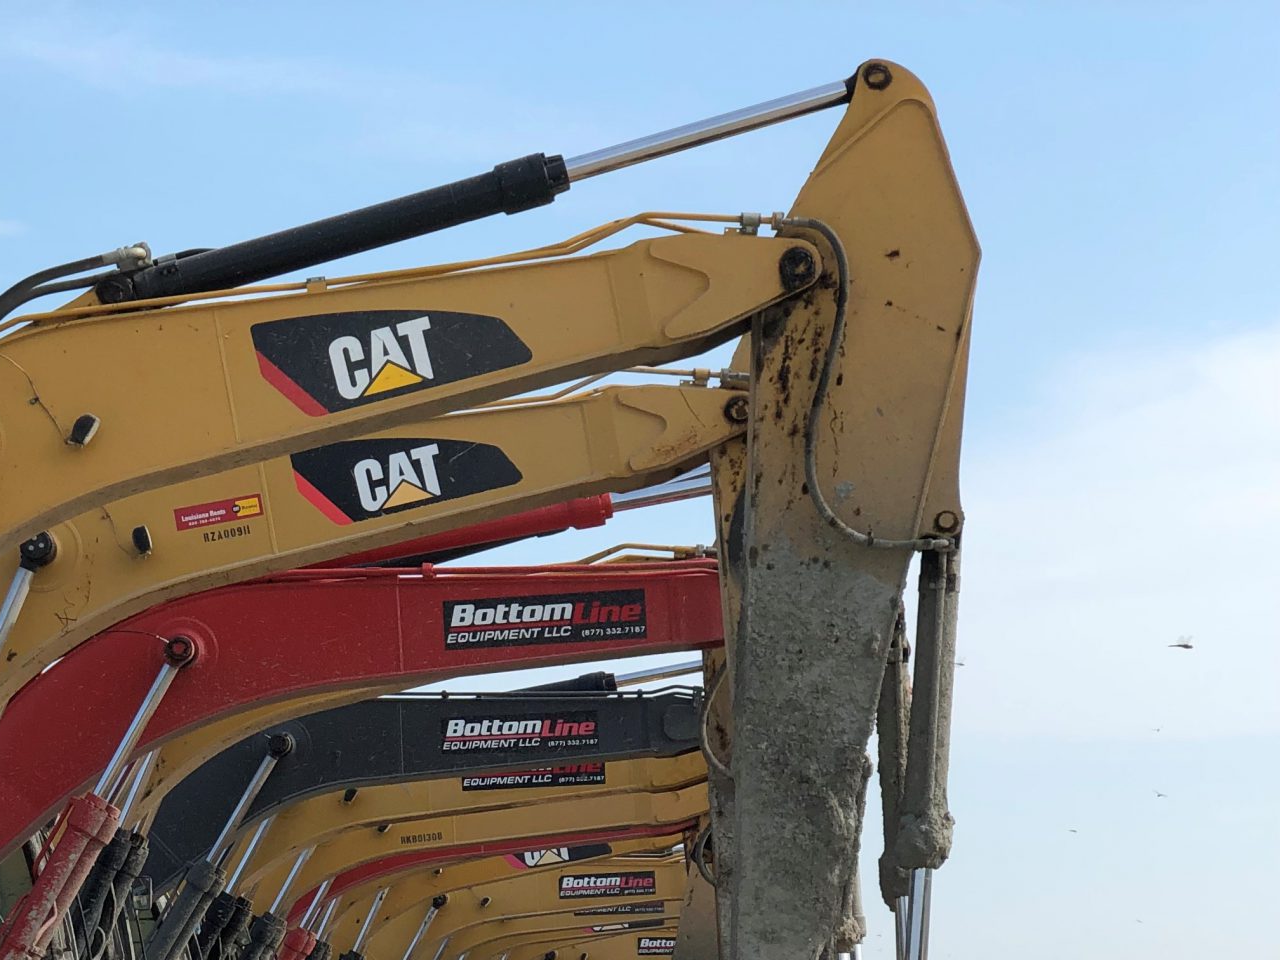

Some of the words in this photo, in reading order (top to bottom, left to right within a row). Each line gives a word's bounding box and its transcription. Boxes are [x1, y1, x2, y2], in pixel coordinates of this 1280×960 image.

[328, 316, 434, 400] CAT
[353, 443, 442, 512] CAT
[446, 627, 542, 644] EQUIPMENT
[544, 625, 572, 638] LLC
[581, 628, 604, 638] (877)
[442, 739, 517, 750] EQUIPMENT
[518, 738, 541, 747] LLC
[463, 775, 531, 787] EQUIPMENT
[532, 774, 553, 783] LLC
[560, 888, 606, 897] EQUIPMENT
